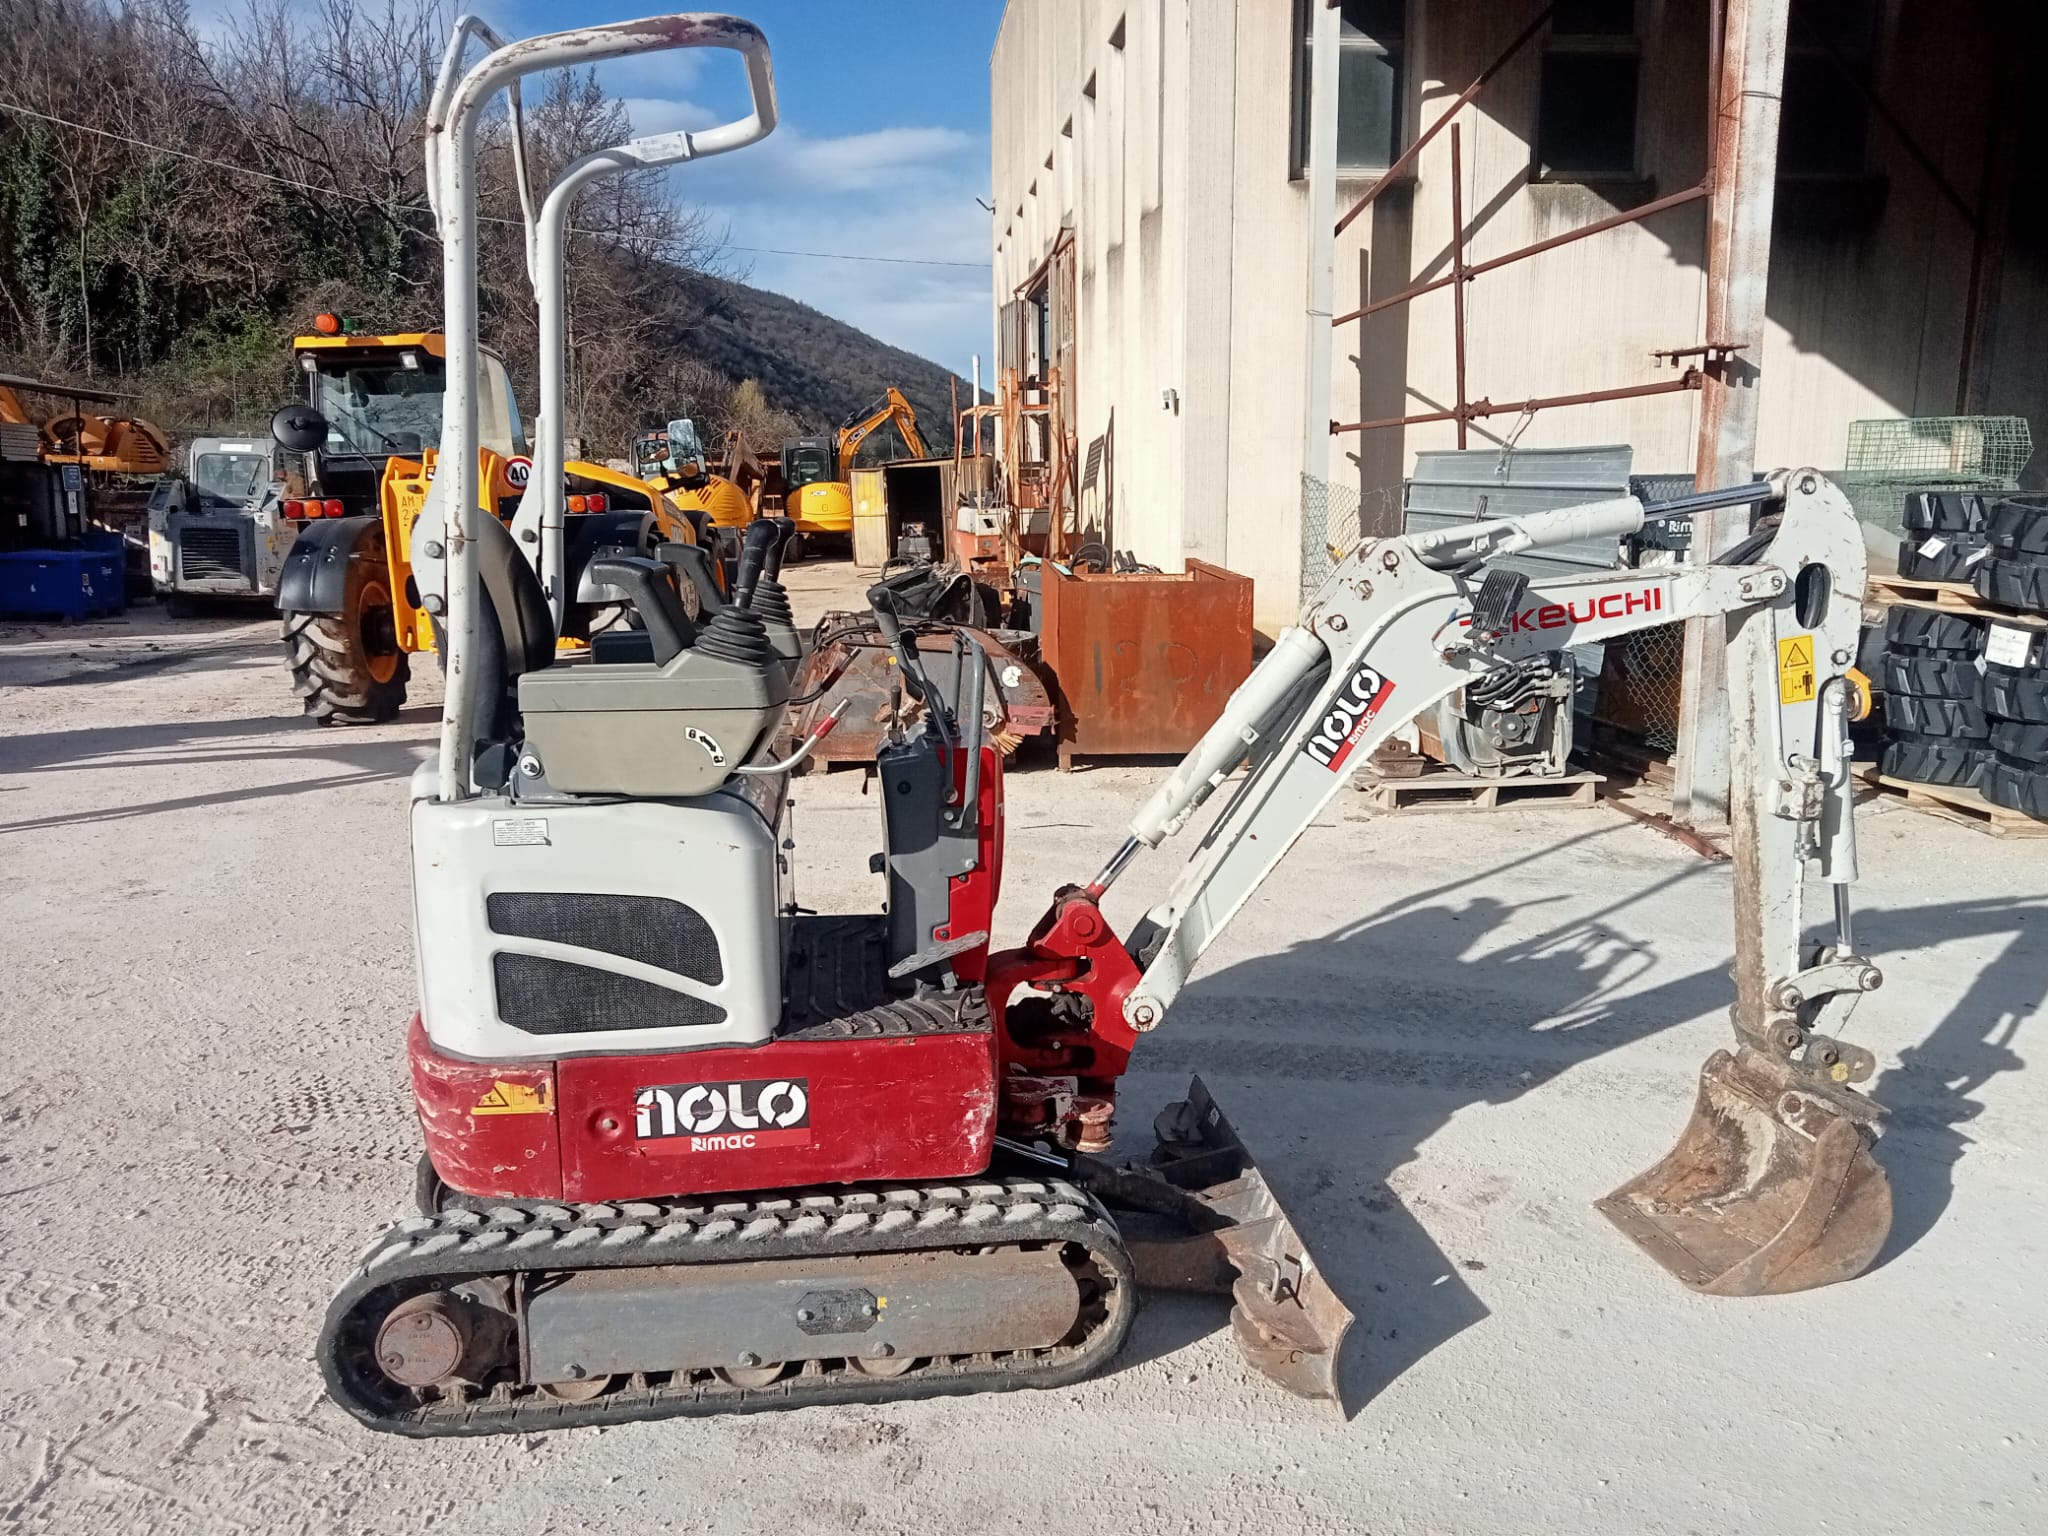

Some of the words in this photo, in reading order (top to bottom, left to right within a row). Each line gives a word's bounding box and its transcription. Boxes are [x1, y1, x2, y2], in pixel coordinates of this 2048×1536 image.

[848, 426, 867, 445] JCB
[510, 466, 529, 482] 40
[402, 495, 415, 507] AM
[1668, 520, 1692, 533] Rim
